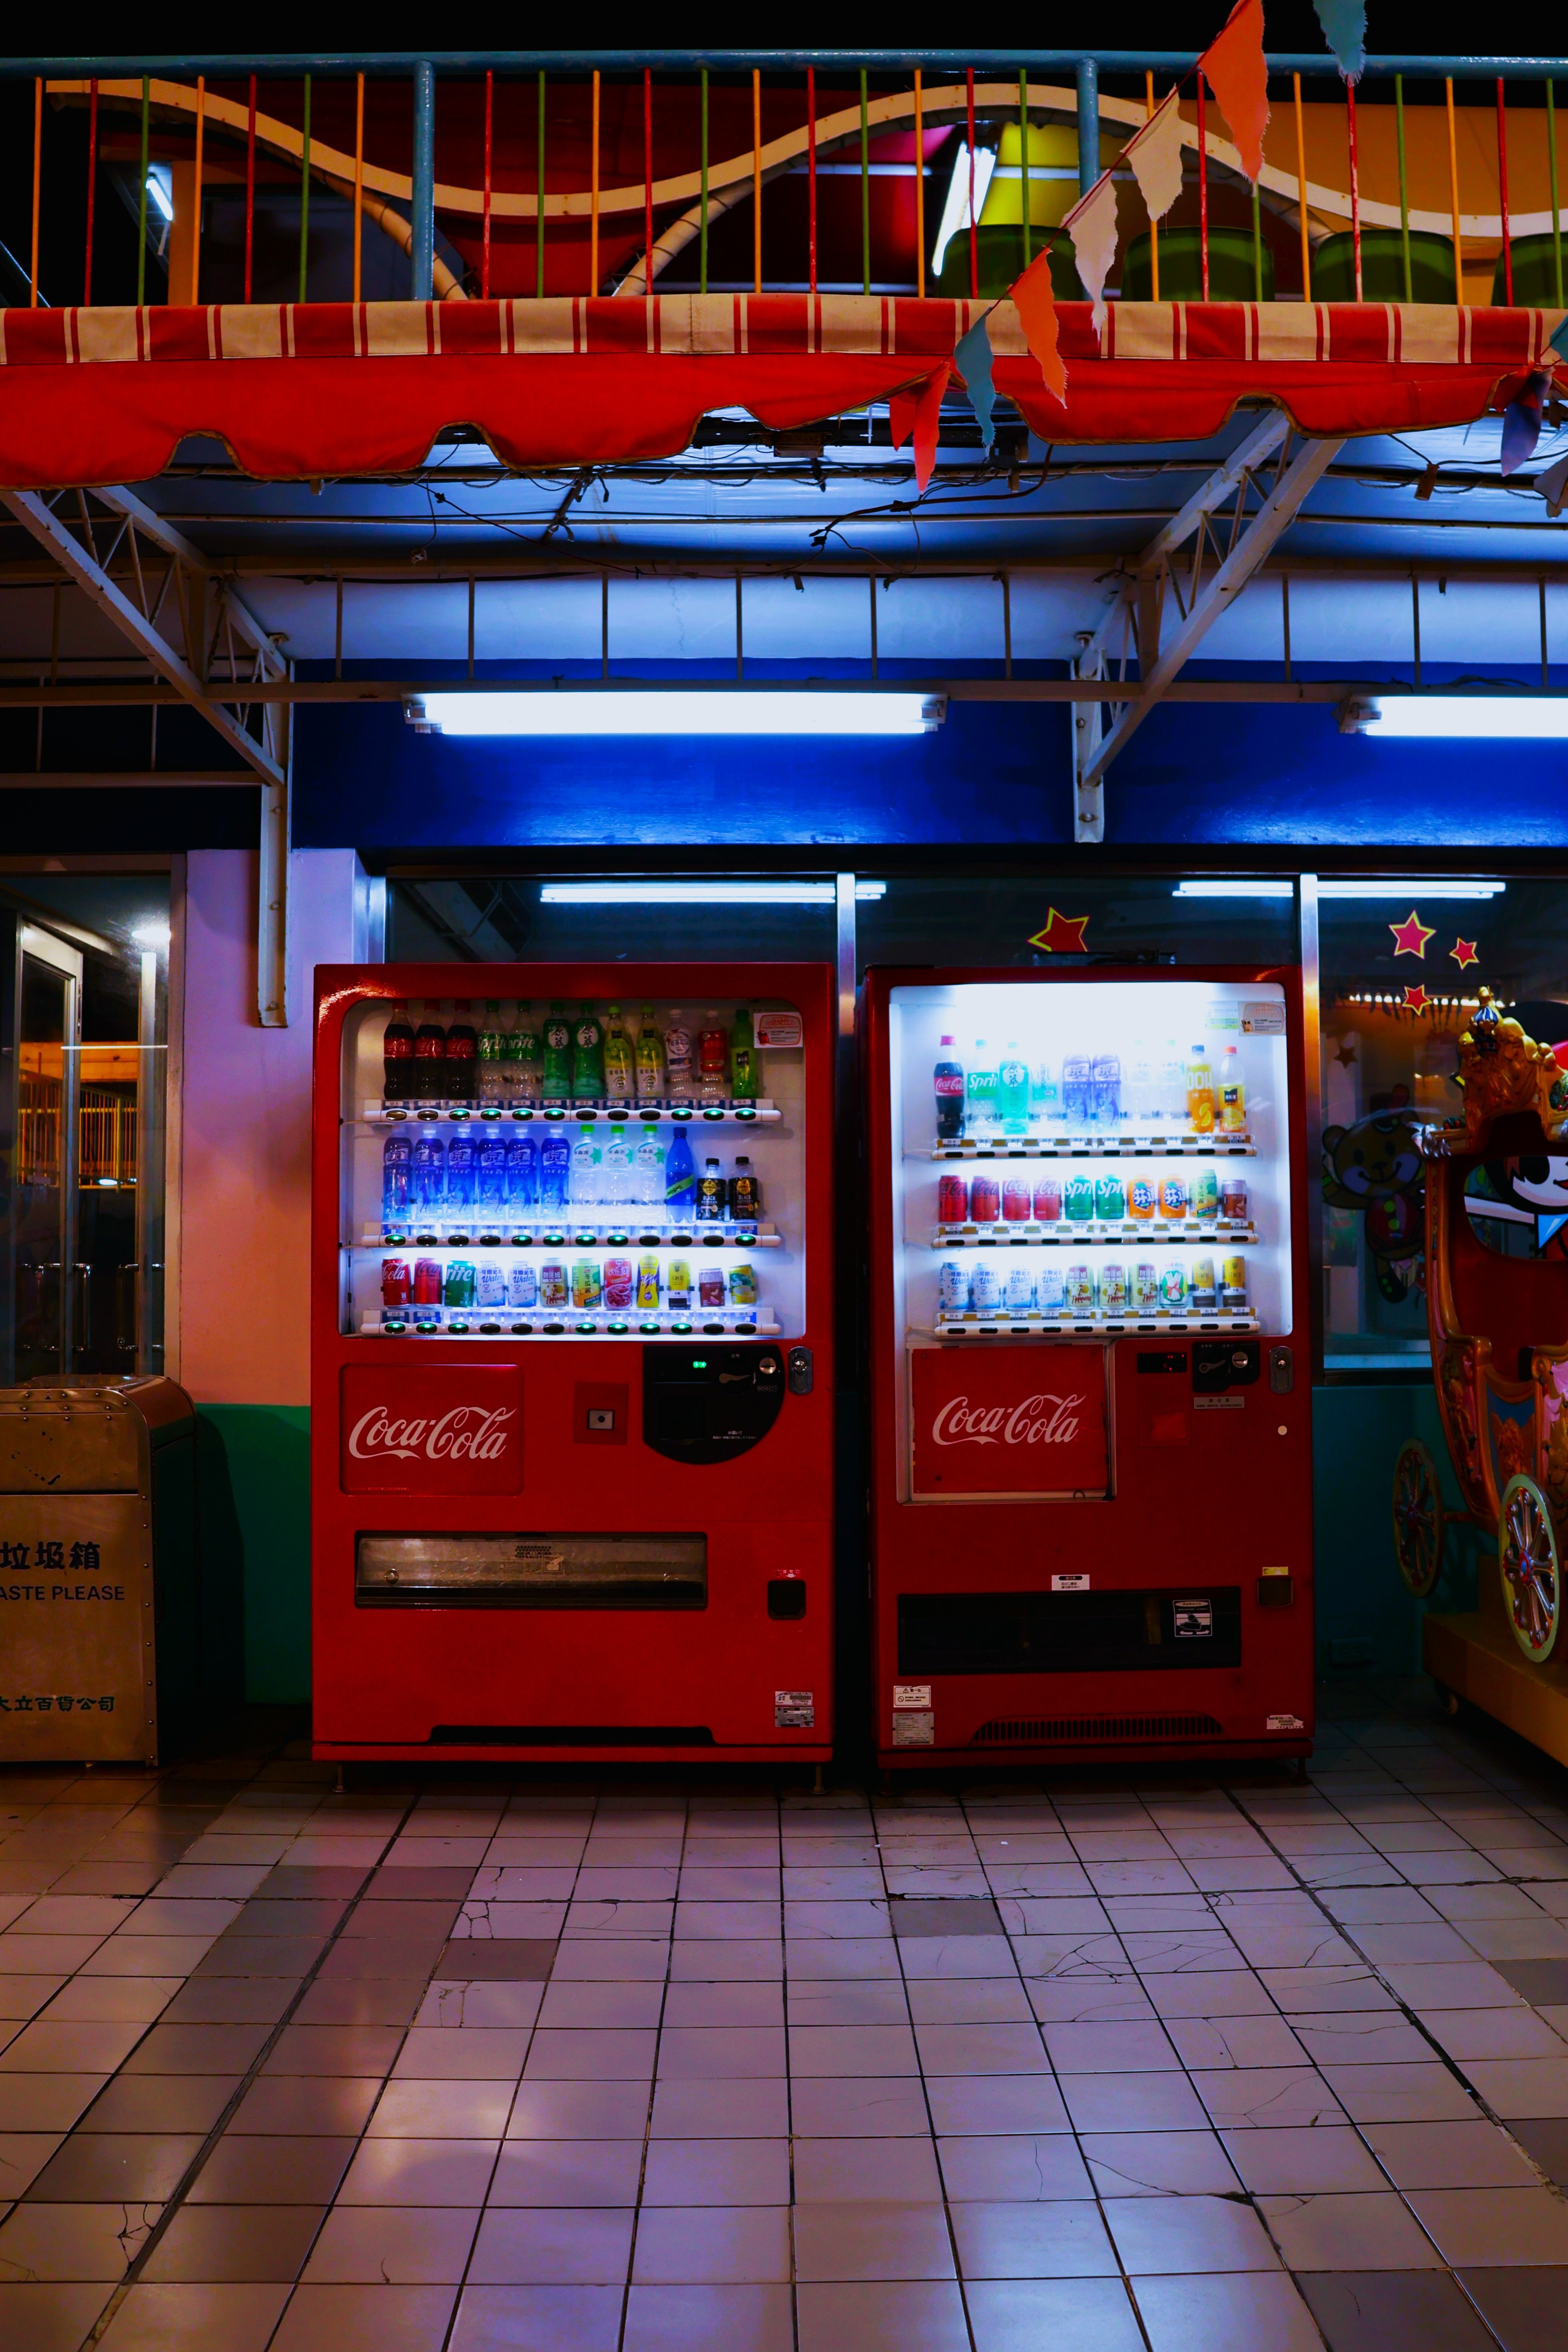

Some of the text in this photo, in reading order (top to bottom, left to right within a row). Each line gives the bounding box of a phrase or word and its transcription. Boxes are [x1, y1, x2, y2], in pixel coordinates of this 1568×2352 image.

[383, 1263, 405, 1280] Cola
[348, 1406, 517, 1460] Coca-Cola
[932, 1394, 1086, 1445] Coca-Cola
[0, 1541, 100, 1570] 垃圾箱
[0, 1585, 125, 1600] ASTE PLEASE
